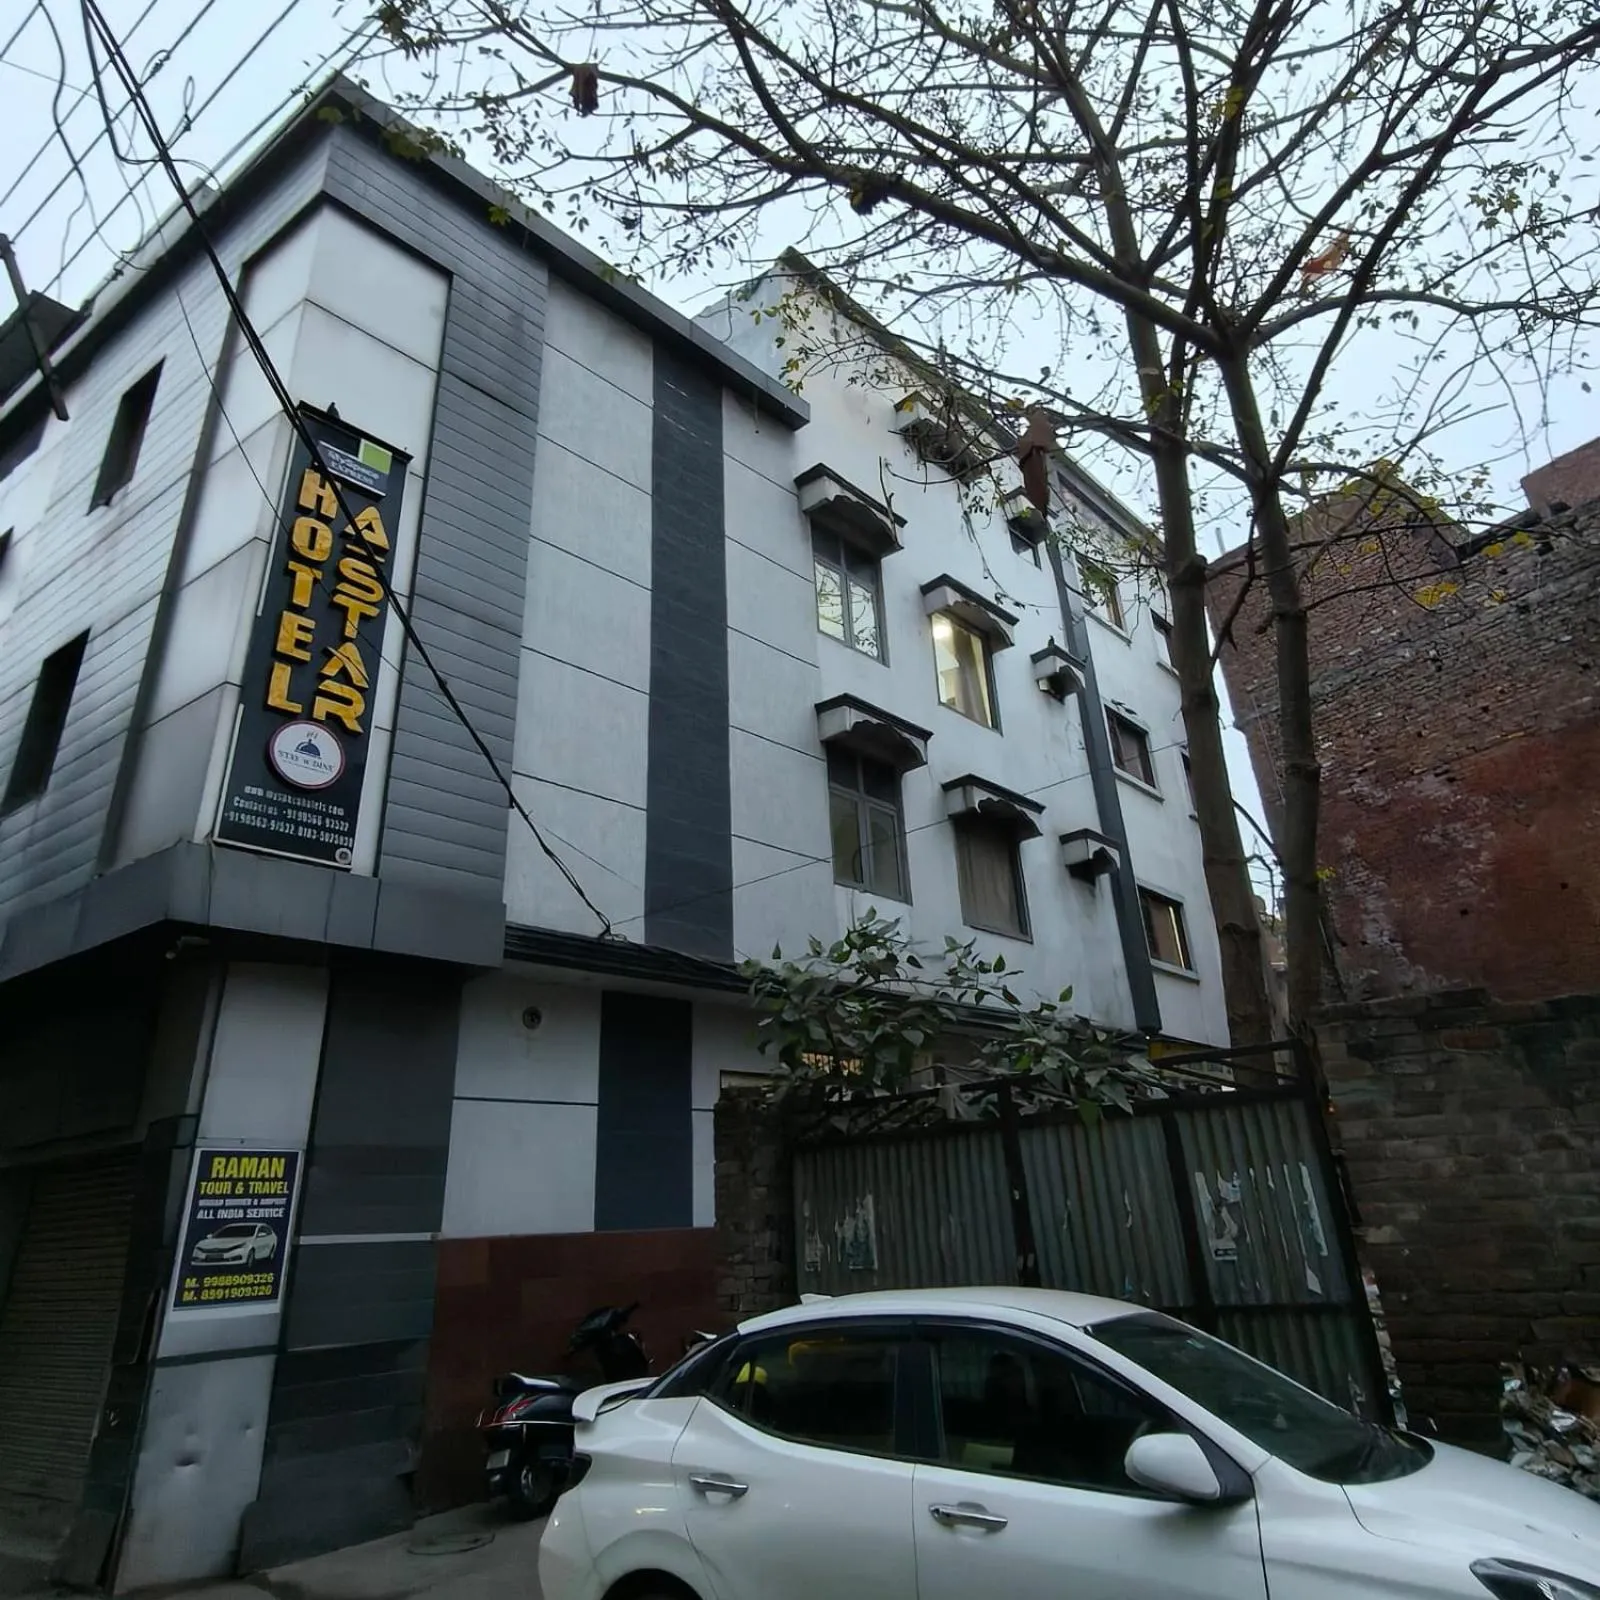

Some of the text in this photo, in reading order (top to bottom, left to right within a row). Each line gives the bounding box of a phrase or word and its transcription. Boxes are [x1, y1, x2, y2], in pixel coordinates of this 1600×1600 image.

[266, 468, 342, 714] HOTEL
[278, 750, 299, 761] STAY
[312, 760, 334, 773] DINE
[211, 1156, 286, 1179] RAMAN
[200, 1181, 290, 1195] TOUR & TRAVEL
[196, 1207, 286, 1219] ALL INDIA SERVICE
[184, 1277, 200, 1289] M.
[182, 1289, 198, 1302] M.
